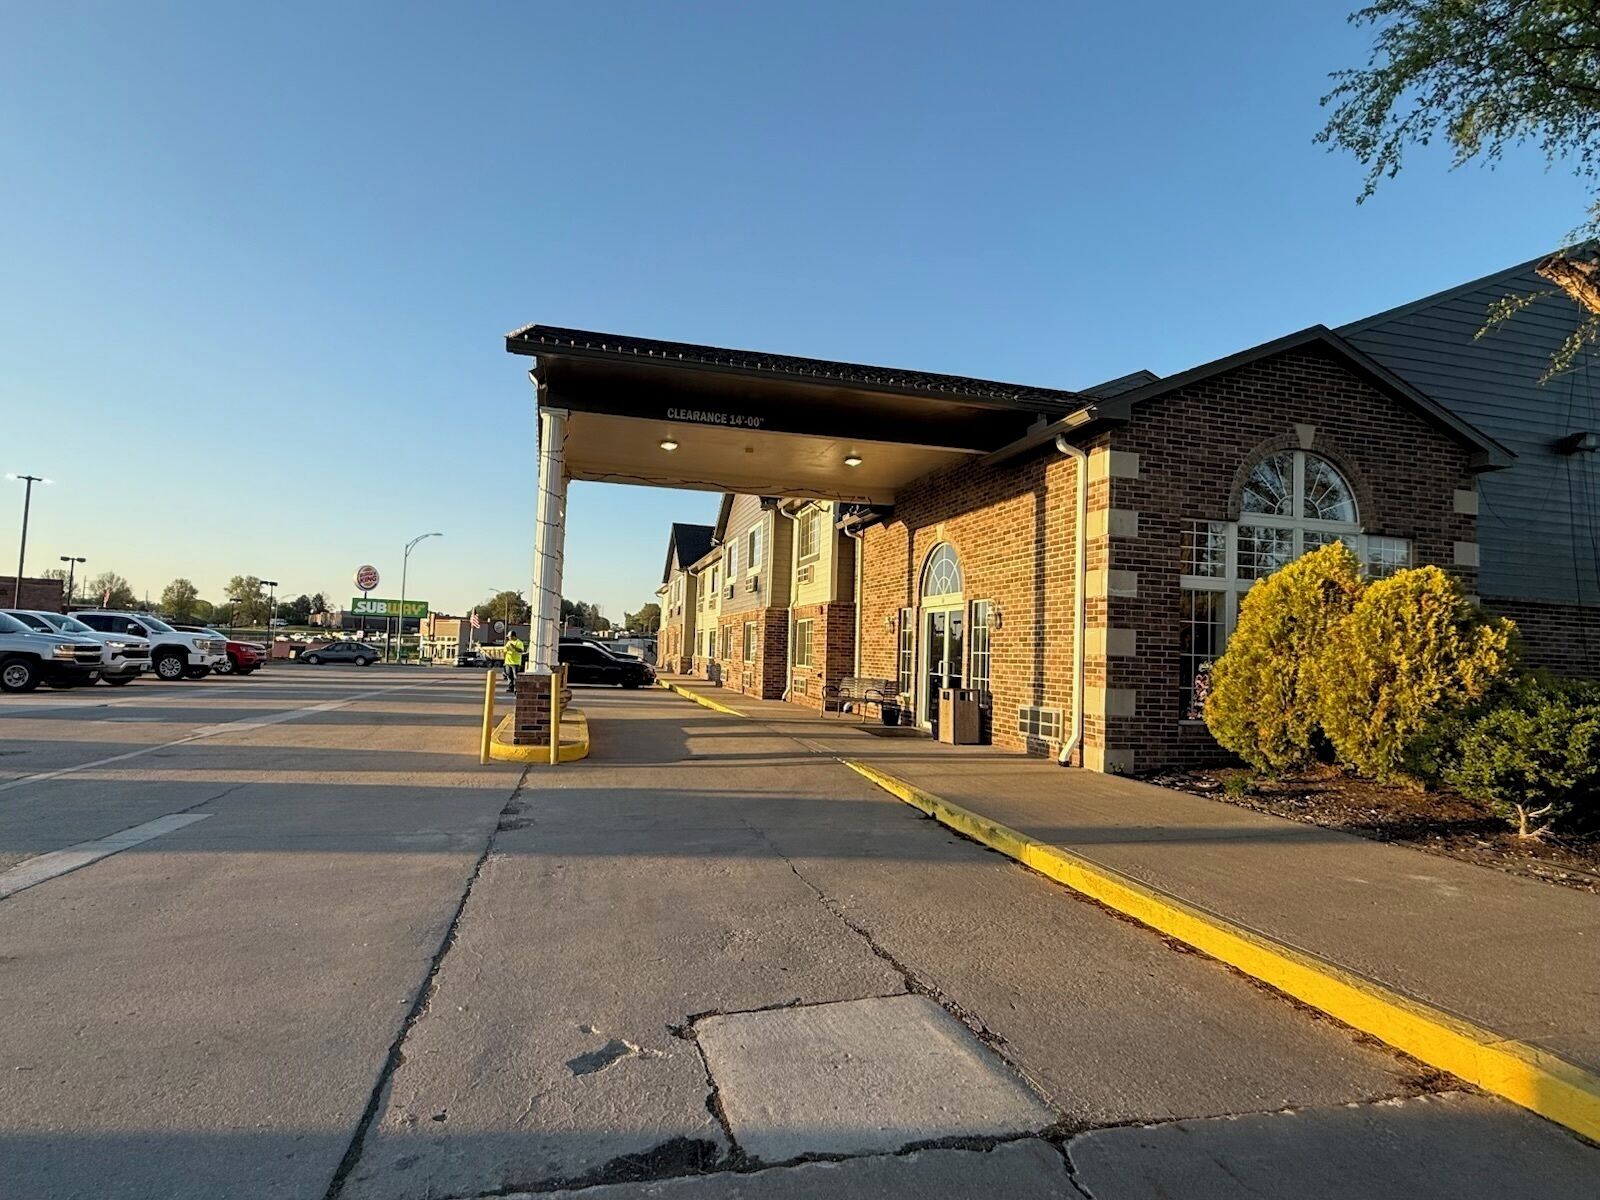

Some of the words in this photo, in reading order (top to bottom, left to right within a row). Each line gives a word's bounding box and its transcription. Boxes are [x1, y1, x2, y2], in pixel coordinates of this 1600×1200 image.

[667, 408, 727, 424] CLEARANCE
[729, 415, 765, 427] 14'-00"
[354, 602, 425, 615] SUBWAY
